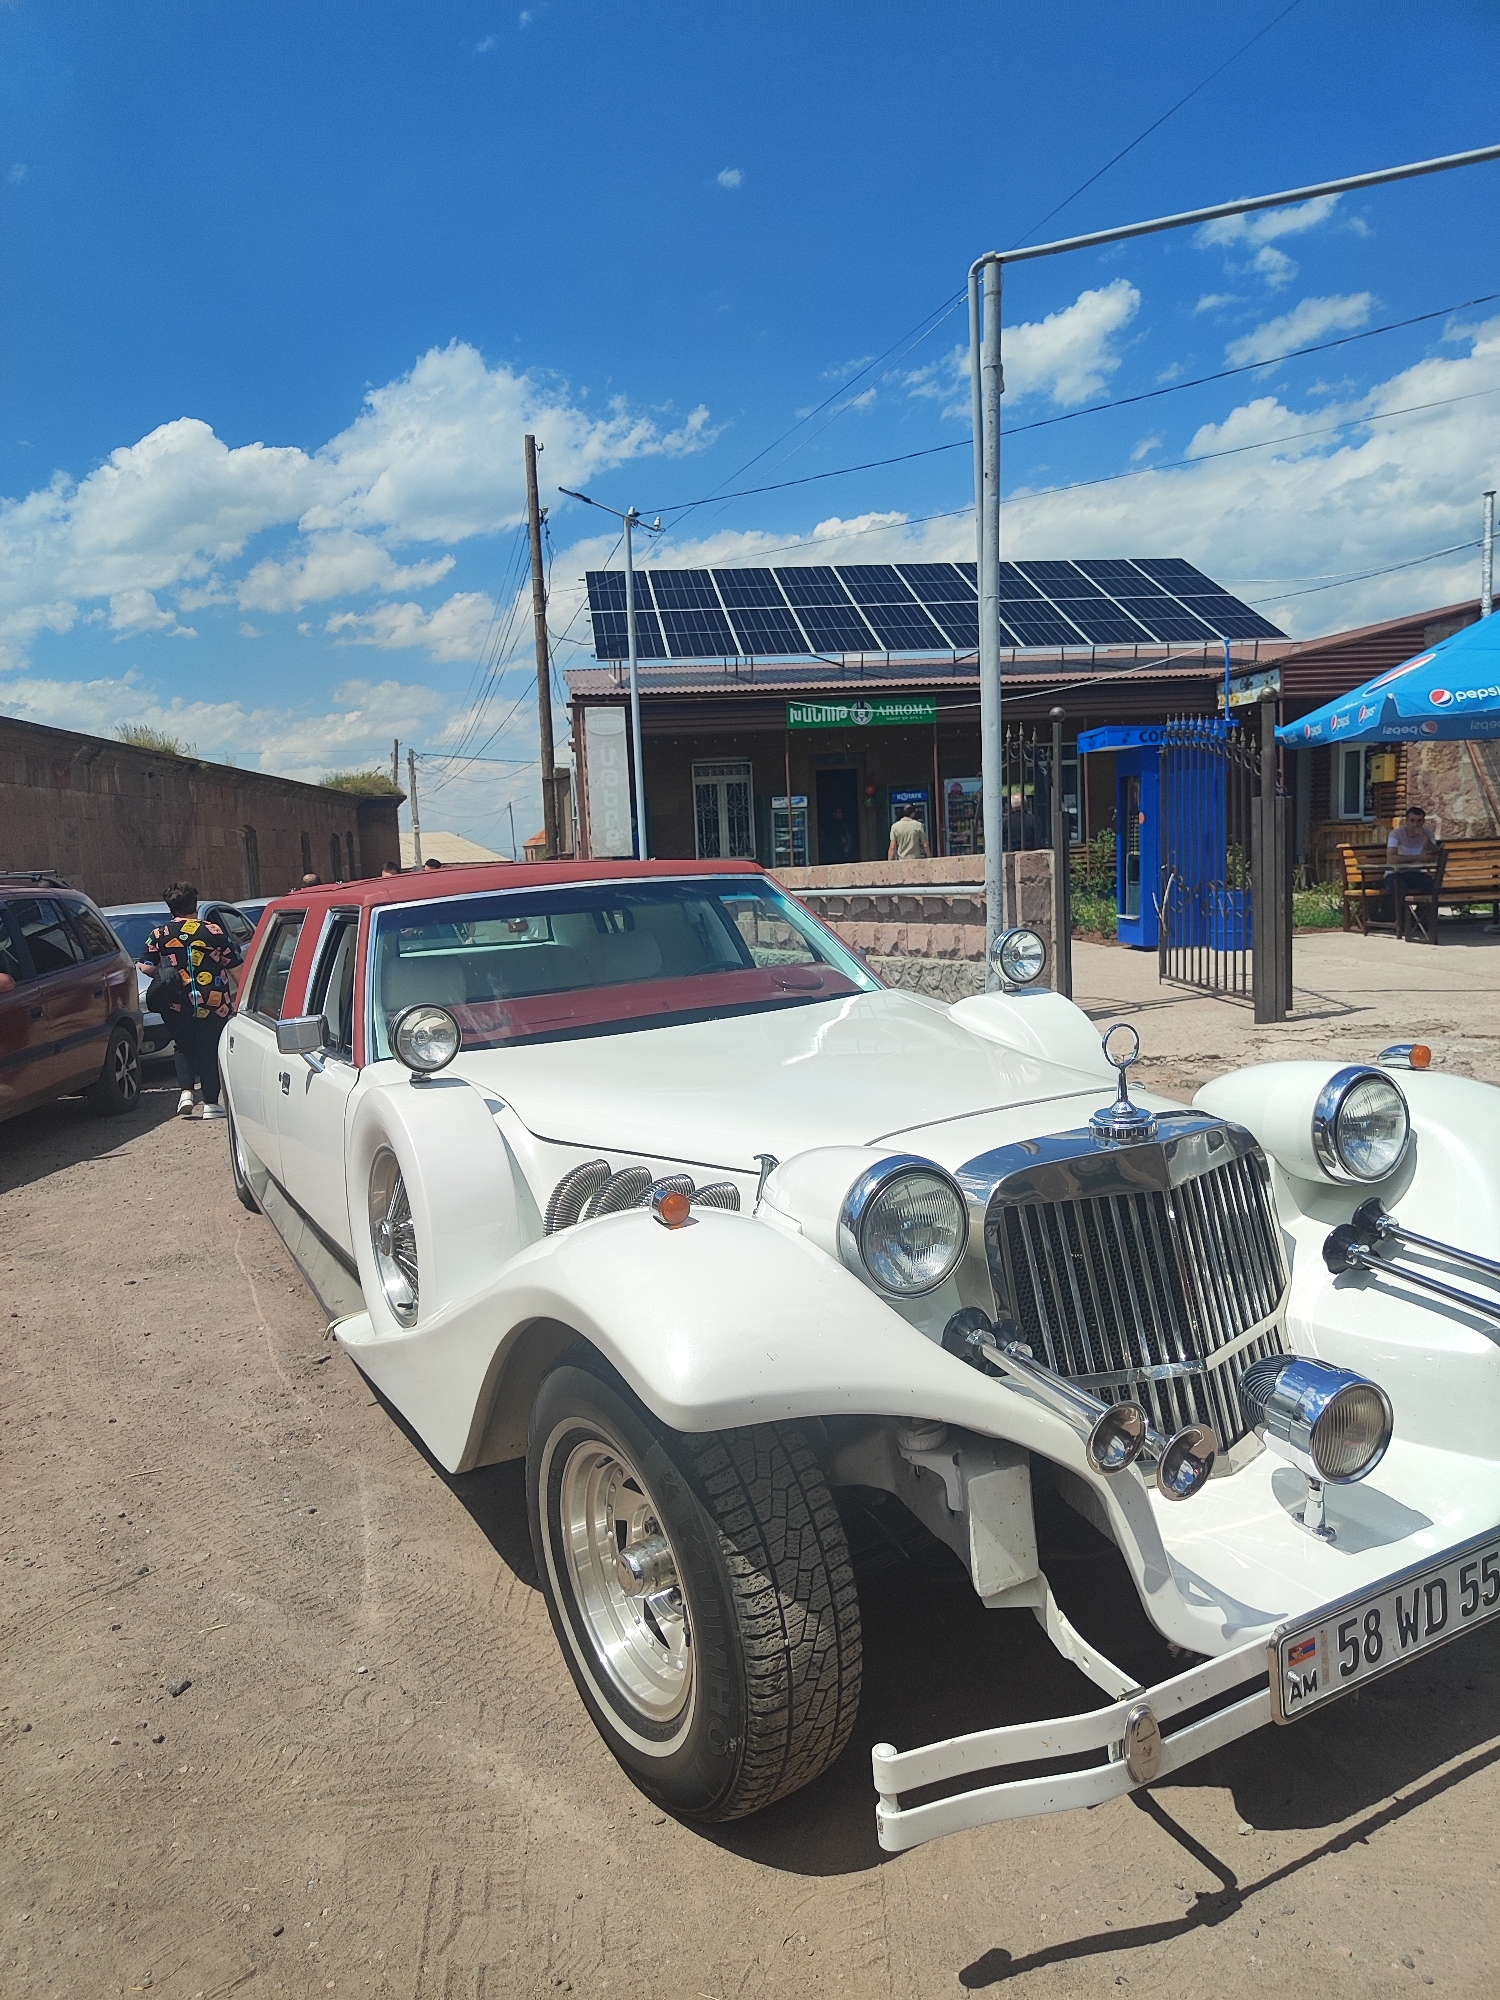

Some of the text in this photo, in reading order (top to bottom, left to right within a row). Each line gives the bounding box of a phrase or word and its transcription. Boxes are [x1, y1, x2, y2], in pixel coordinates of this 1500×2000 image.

[877, 703, 932, 716] ARROMA
[896, 792, 922, 801] KOTAYK
[1337, 1608, 1383, 1677] 58
[1395, 1577, 1448, 1649] WD
[1289, 1669, 1318, 1704] AM
